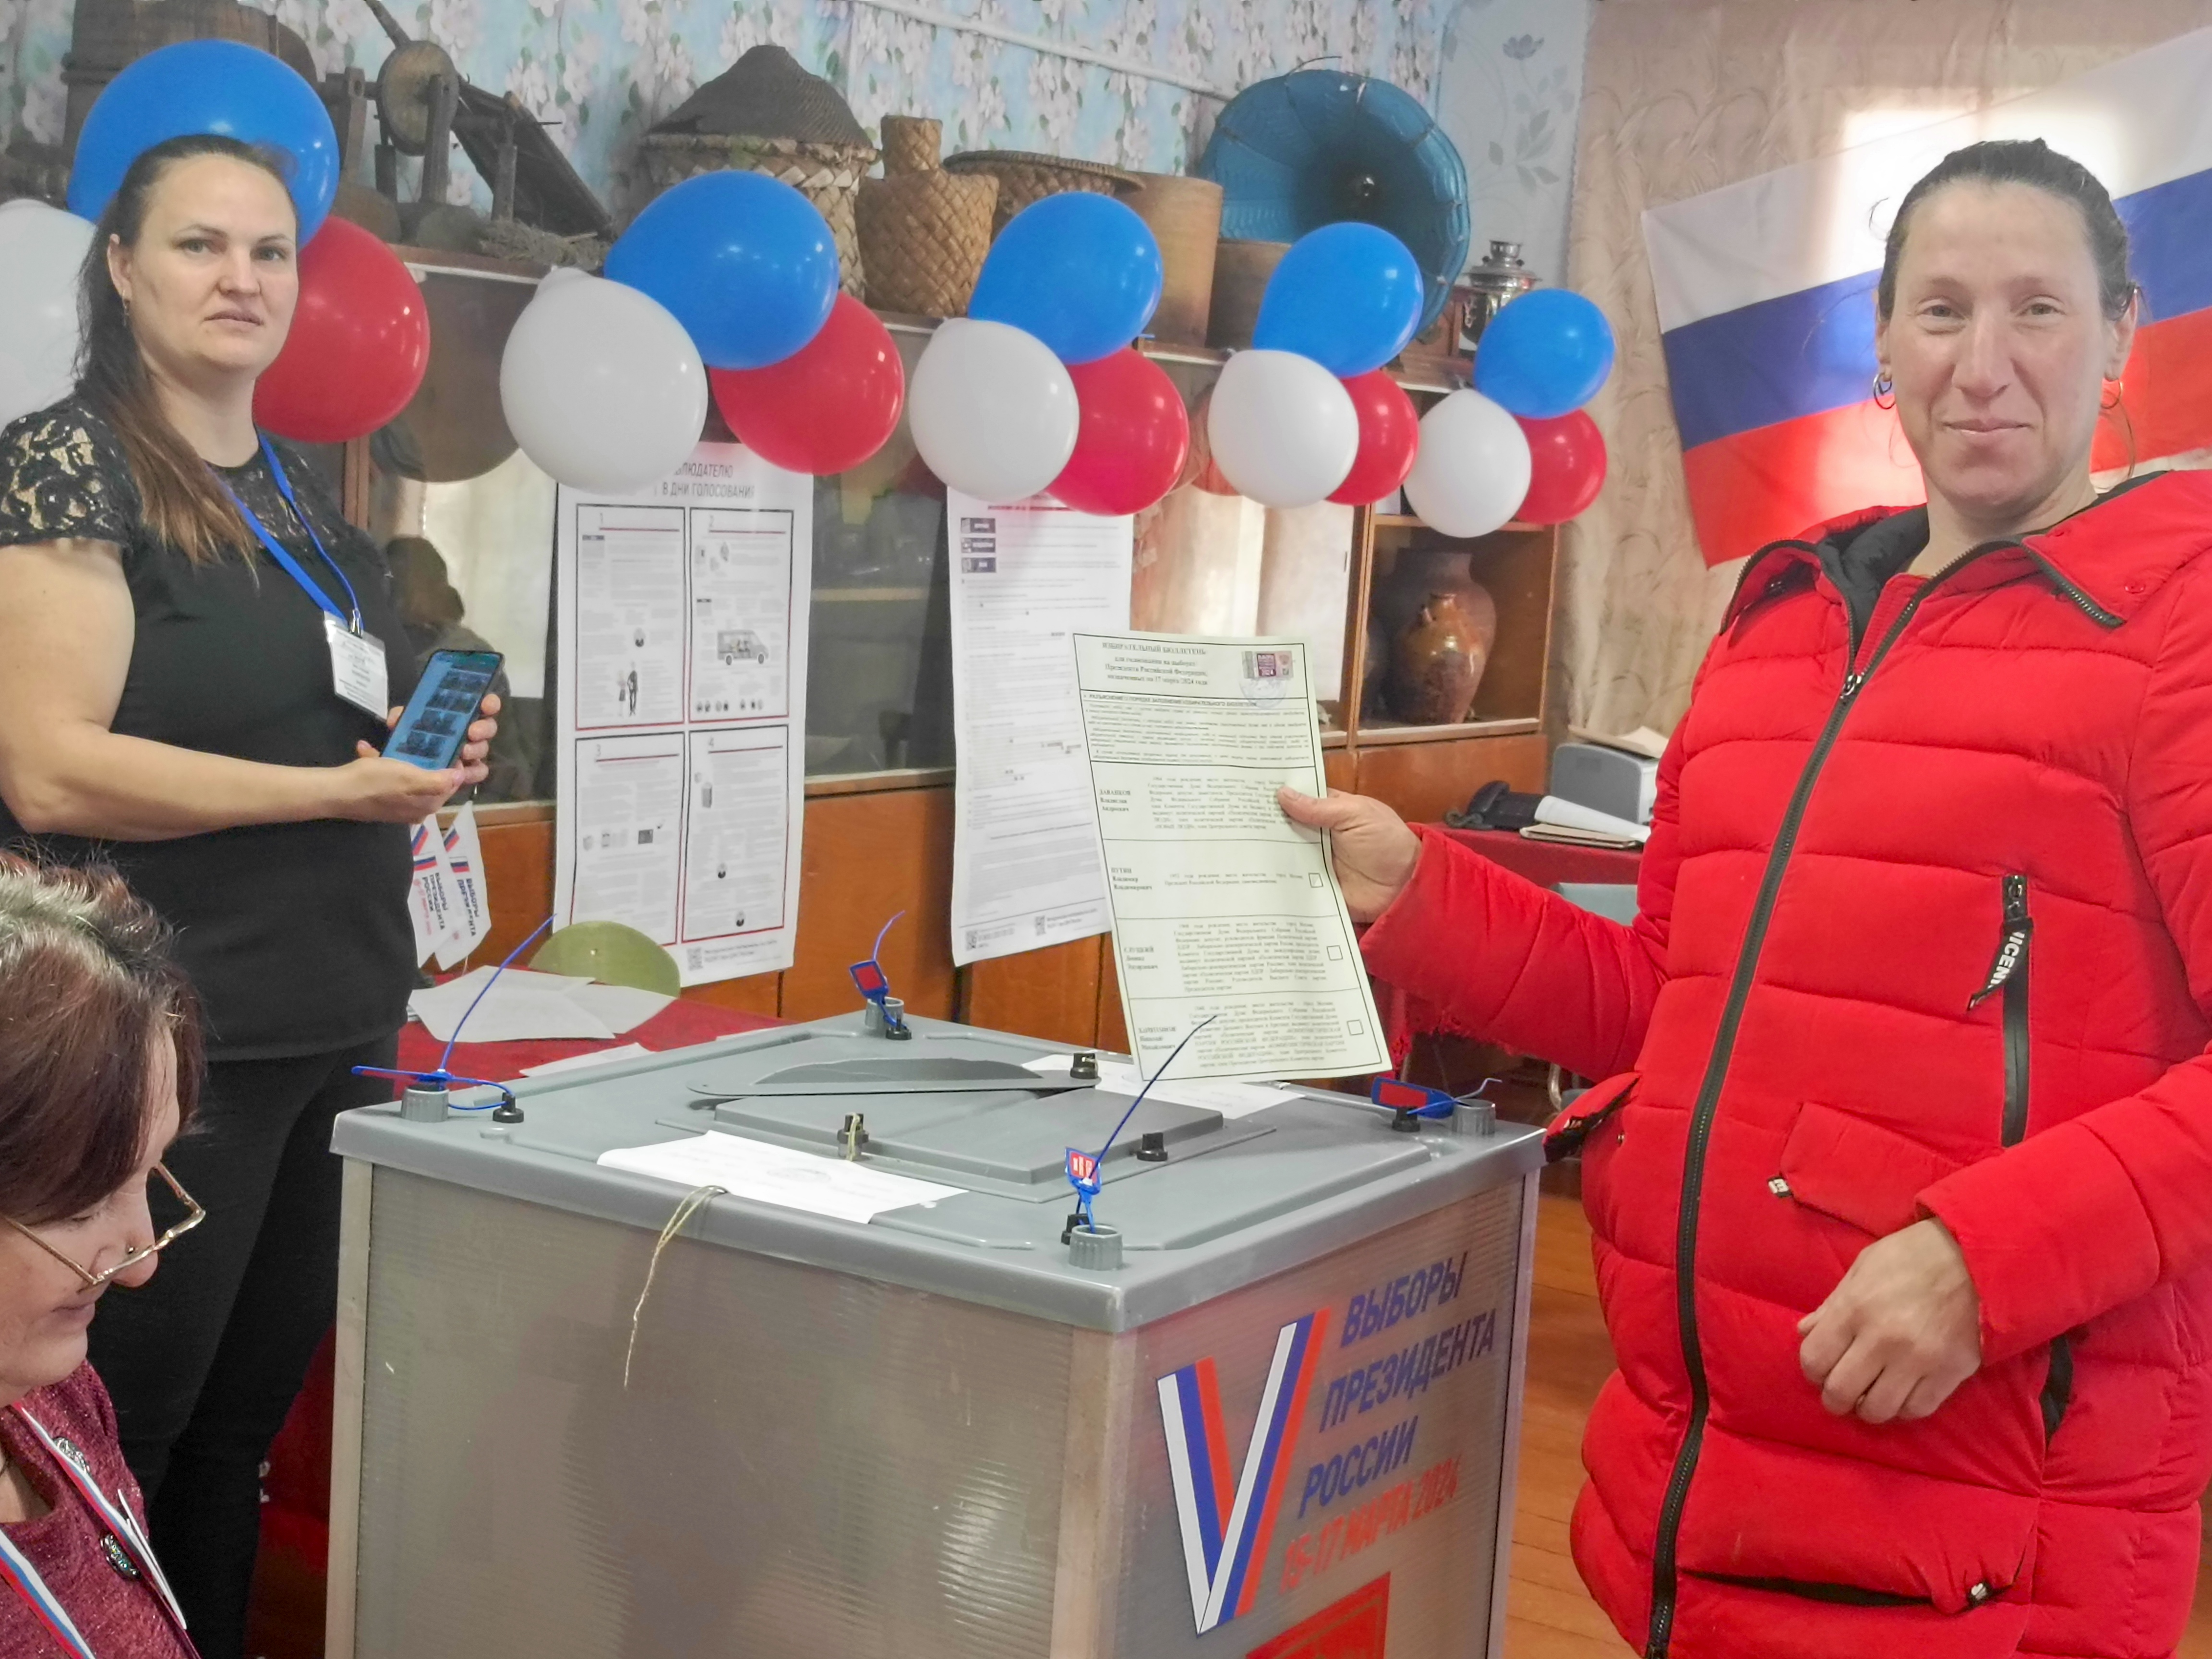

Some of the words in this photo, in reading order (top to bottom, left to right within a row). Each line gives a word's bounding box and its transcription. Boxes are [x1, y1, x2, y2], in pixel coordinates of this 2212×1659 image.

[662, 481, 668, 495] В
[670, 482, 690, 496] ДНИ
[1340, 1250, 1468, 1348] ВЫБОРЫ
[1320, 1308, 1497, 1433] ПРЕЗИДЕНТА
[1298, 1415, 1419, 1519] РОССИИ
[1279, 1514, 1345, 1596] 15-17
[1339, 1480, 1414, 1562] МАРТА
[1412, 1453, 1462, 1521] 2024
